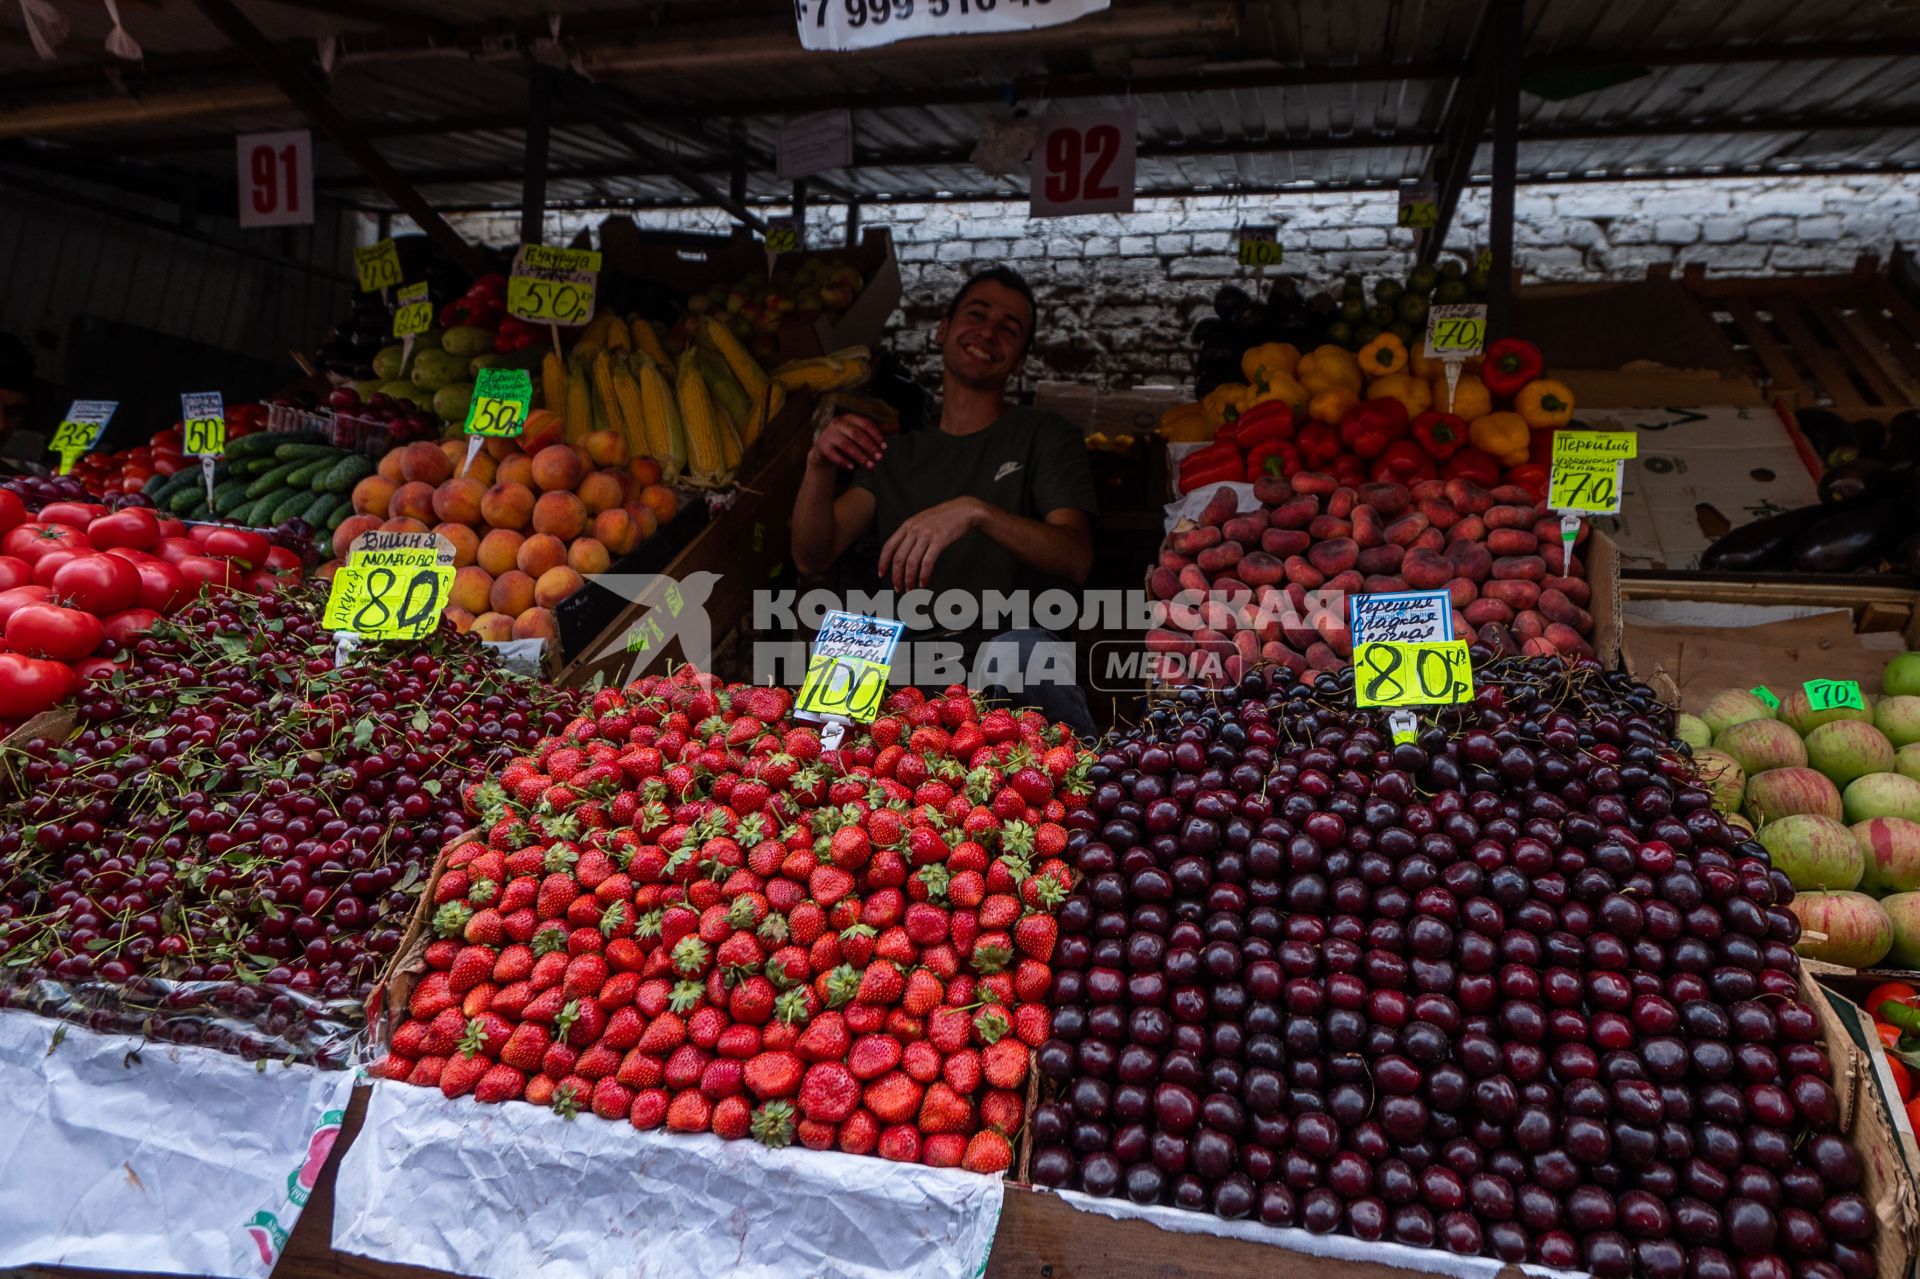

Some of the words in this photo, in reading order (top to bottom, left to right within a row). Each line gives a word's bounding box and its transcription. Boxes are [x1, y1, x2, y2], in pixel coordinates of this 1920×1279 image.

[251, 143, 298, 214] 91
[1045, 124, 1121, 203] 92
[359, 531, 437, 551] Вишня
